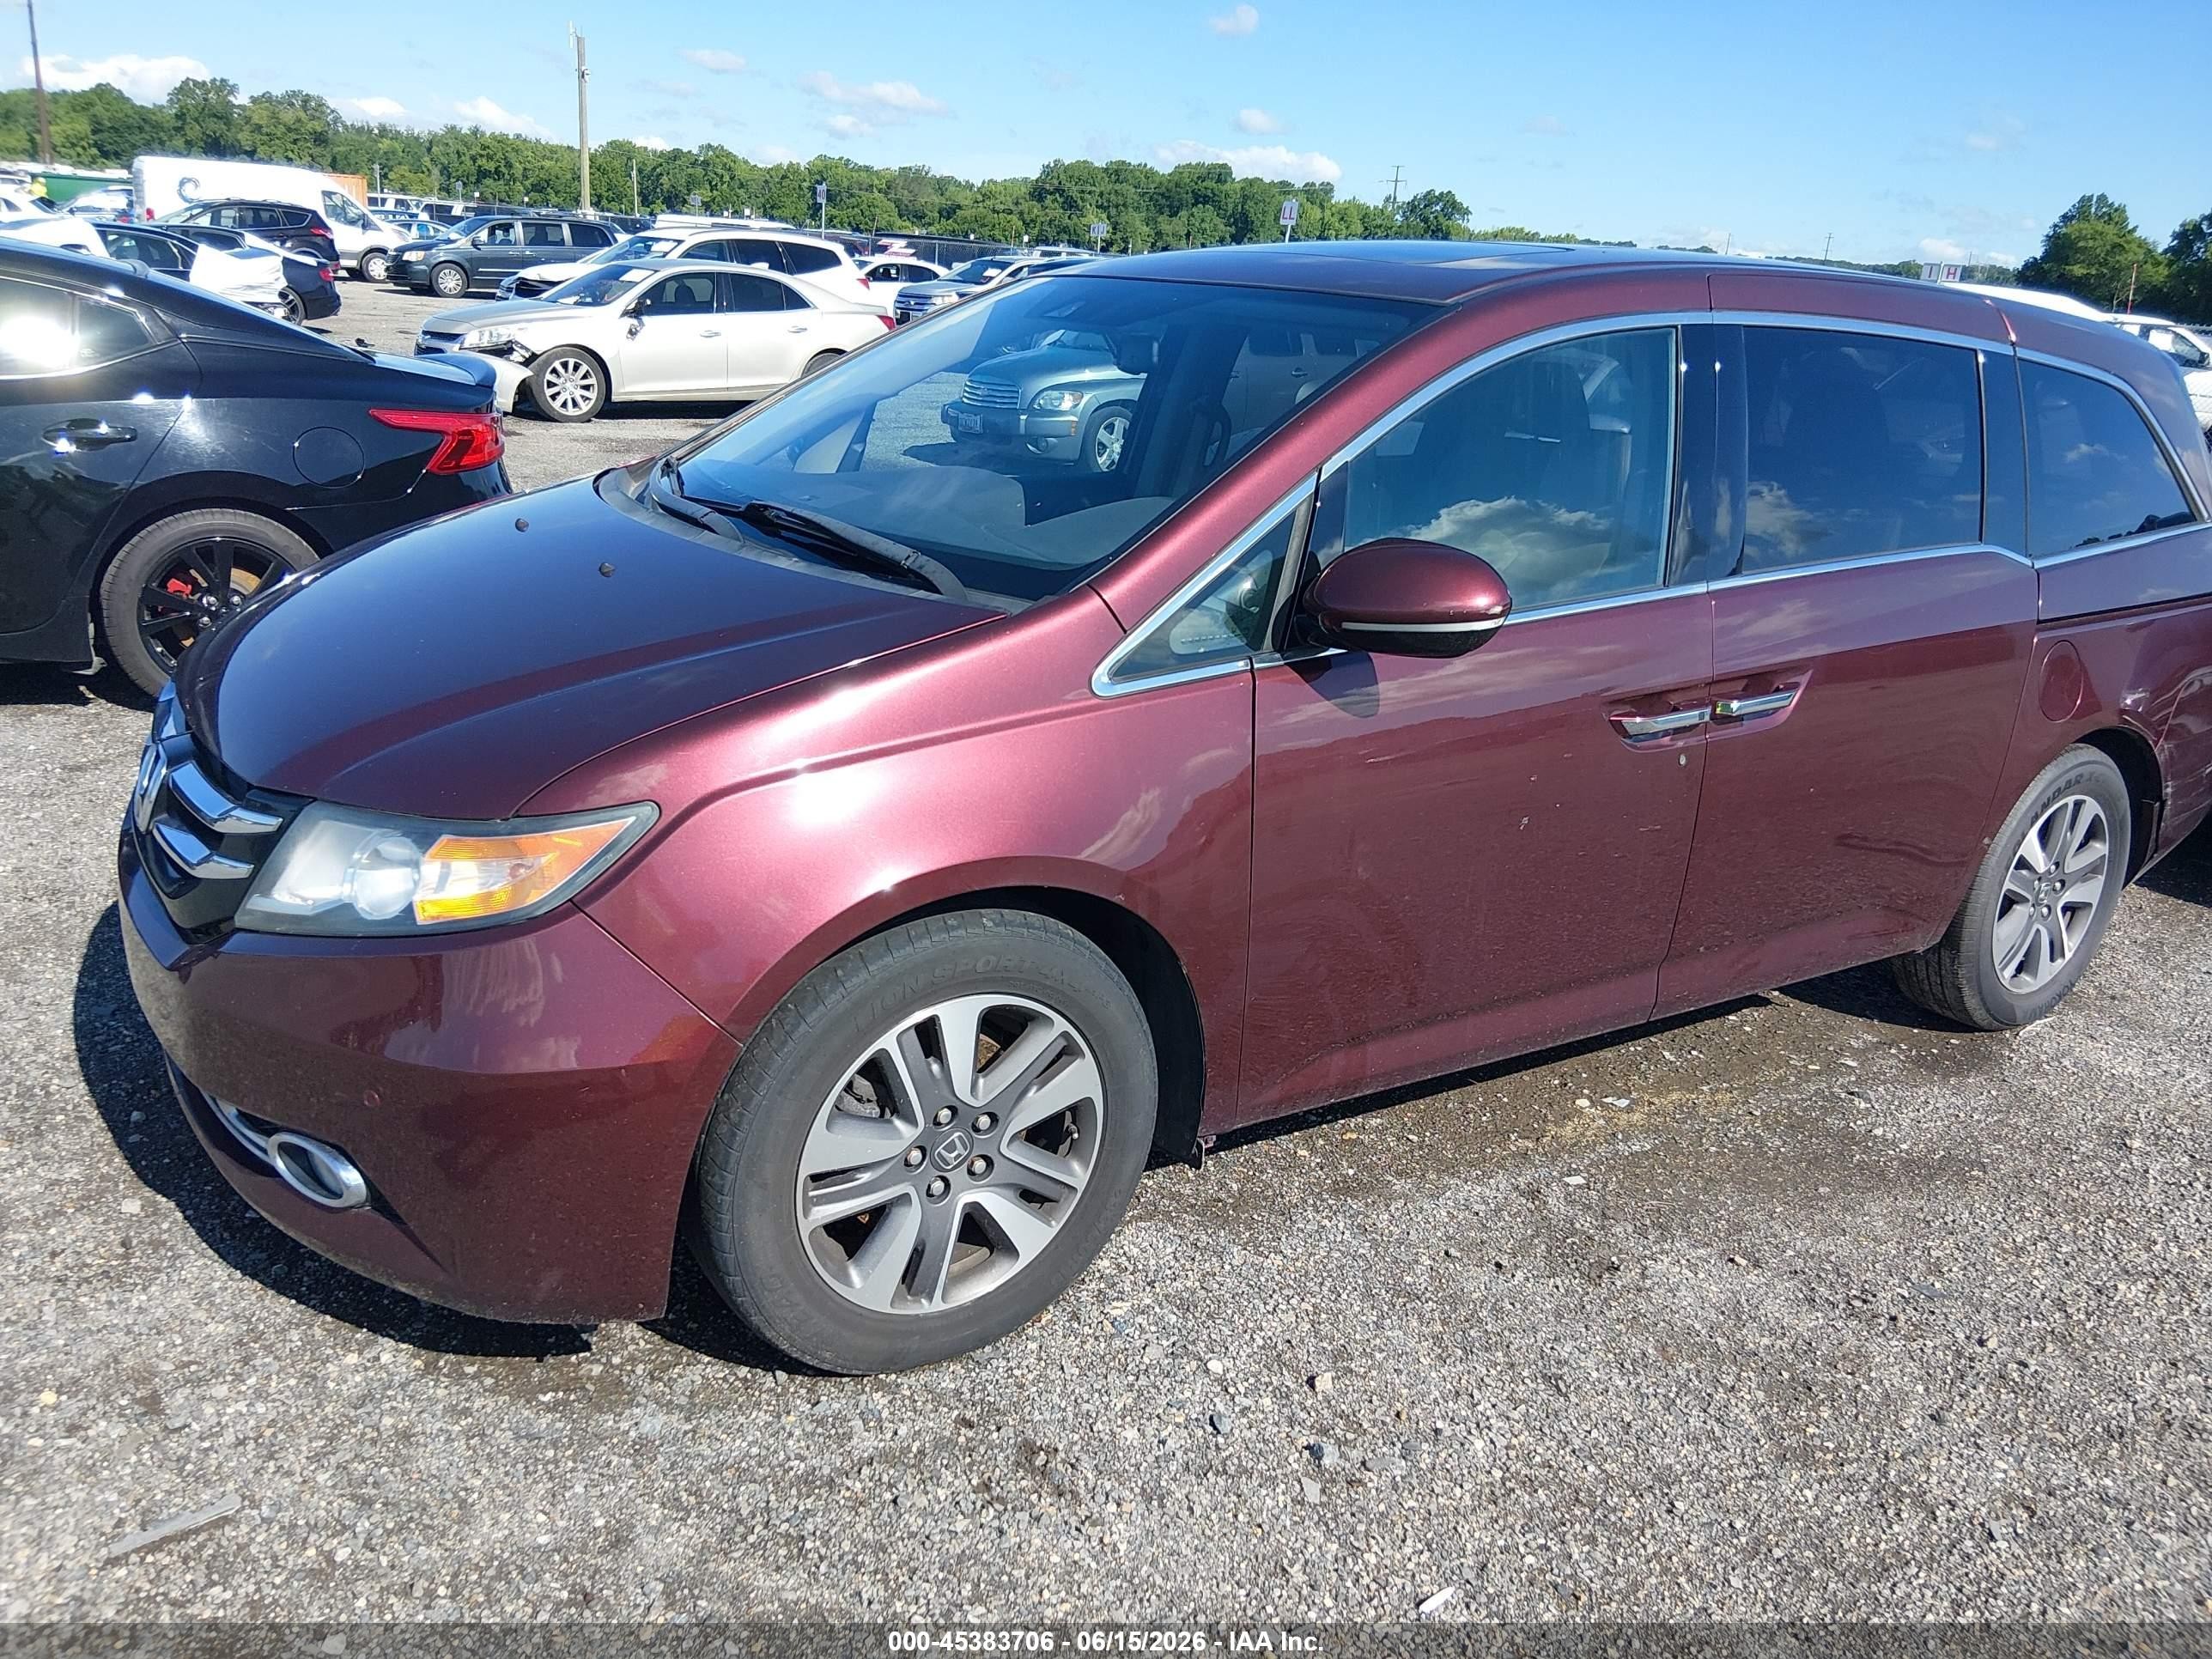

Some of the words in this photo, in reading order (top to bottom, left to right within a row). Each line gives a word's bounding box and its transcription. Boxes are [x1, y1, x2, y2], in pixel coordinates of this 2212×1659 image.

[817, 189, 826, 200] 40
[1281, 205, 1295, 221] LL
[1946, 266, 1958, 280] H
[930, 953, 1037, 986] SPORT
